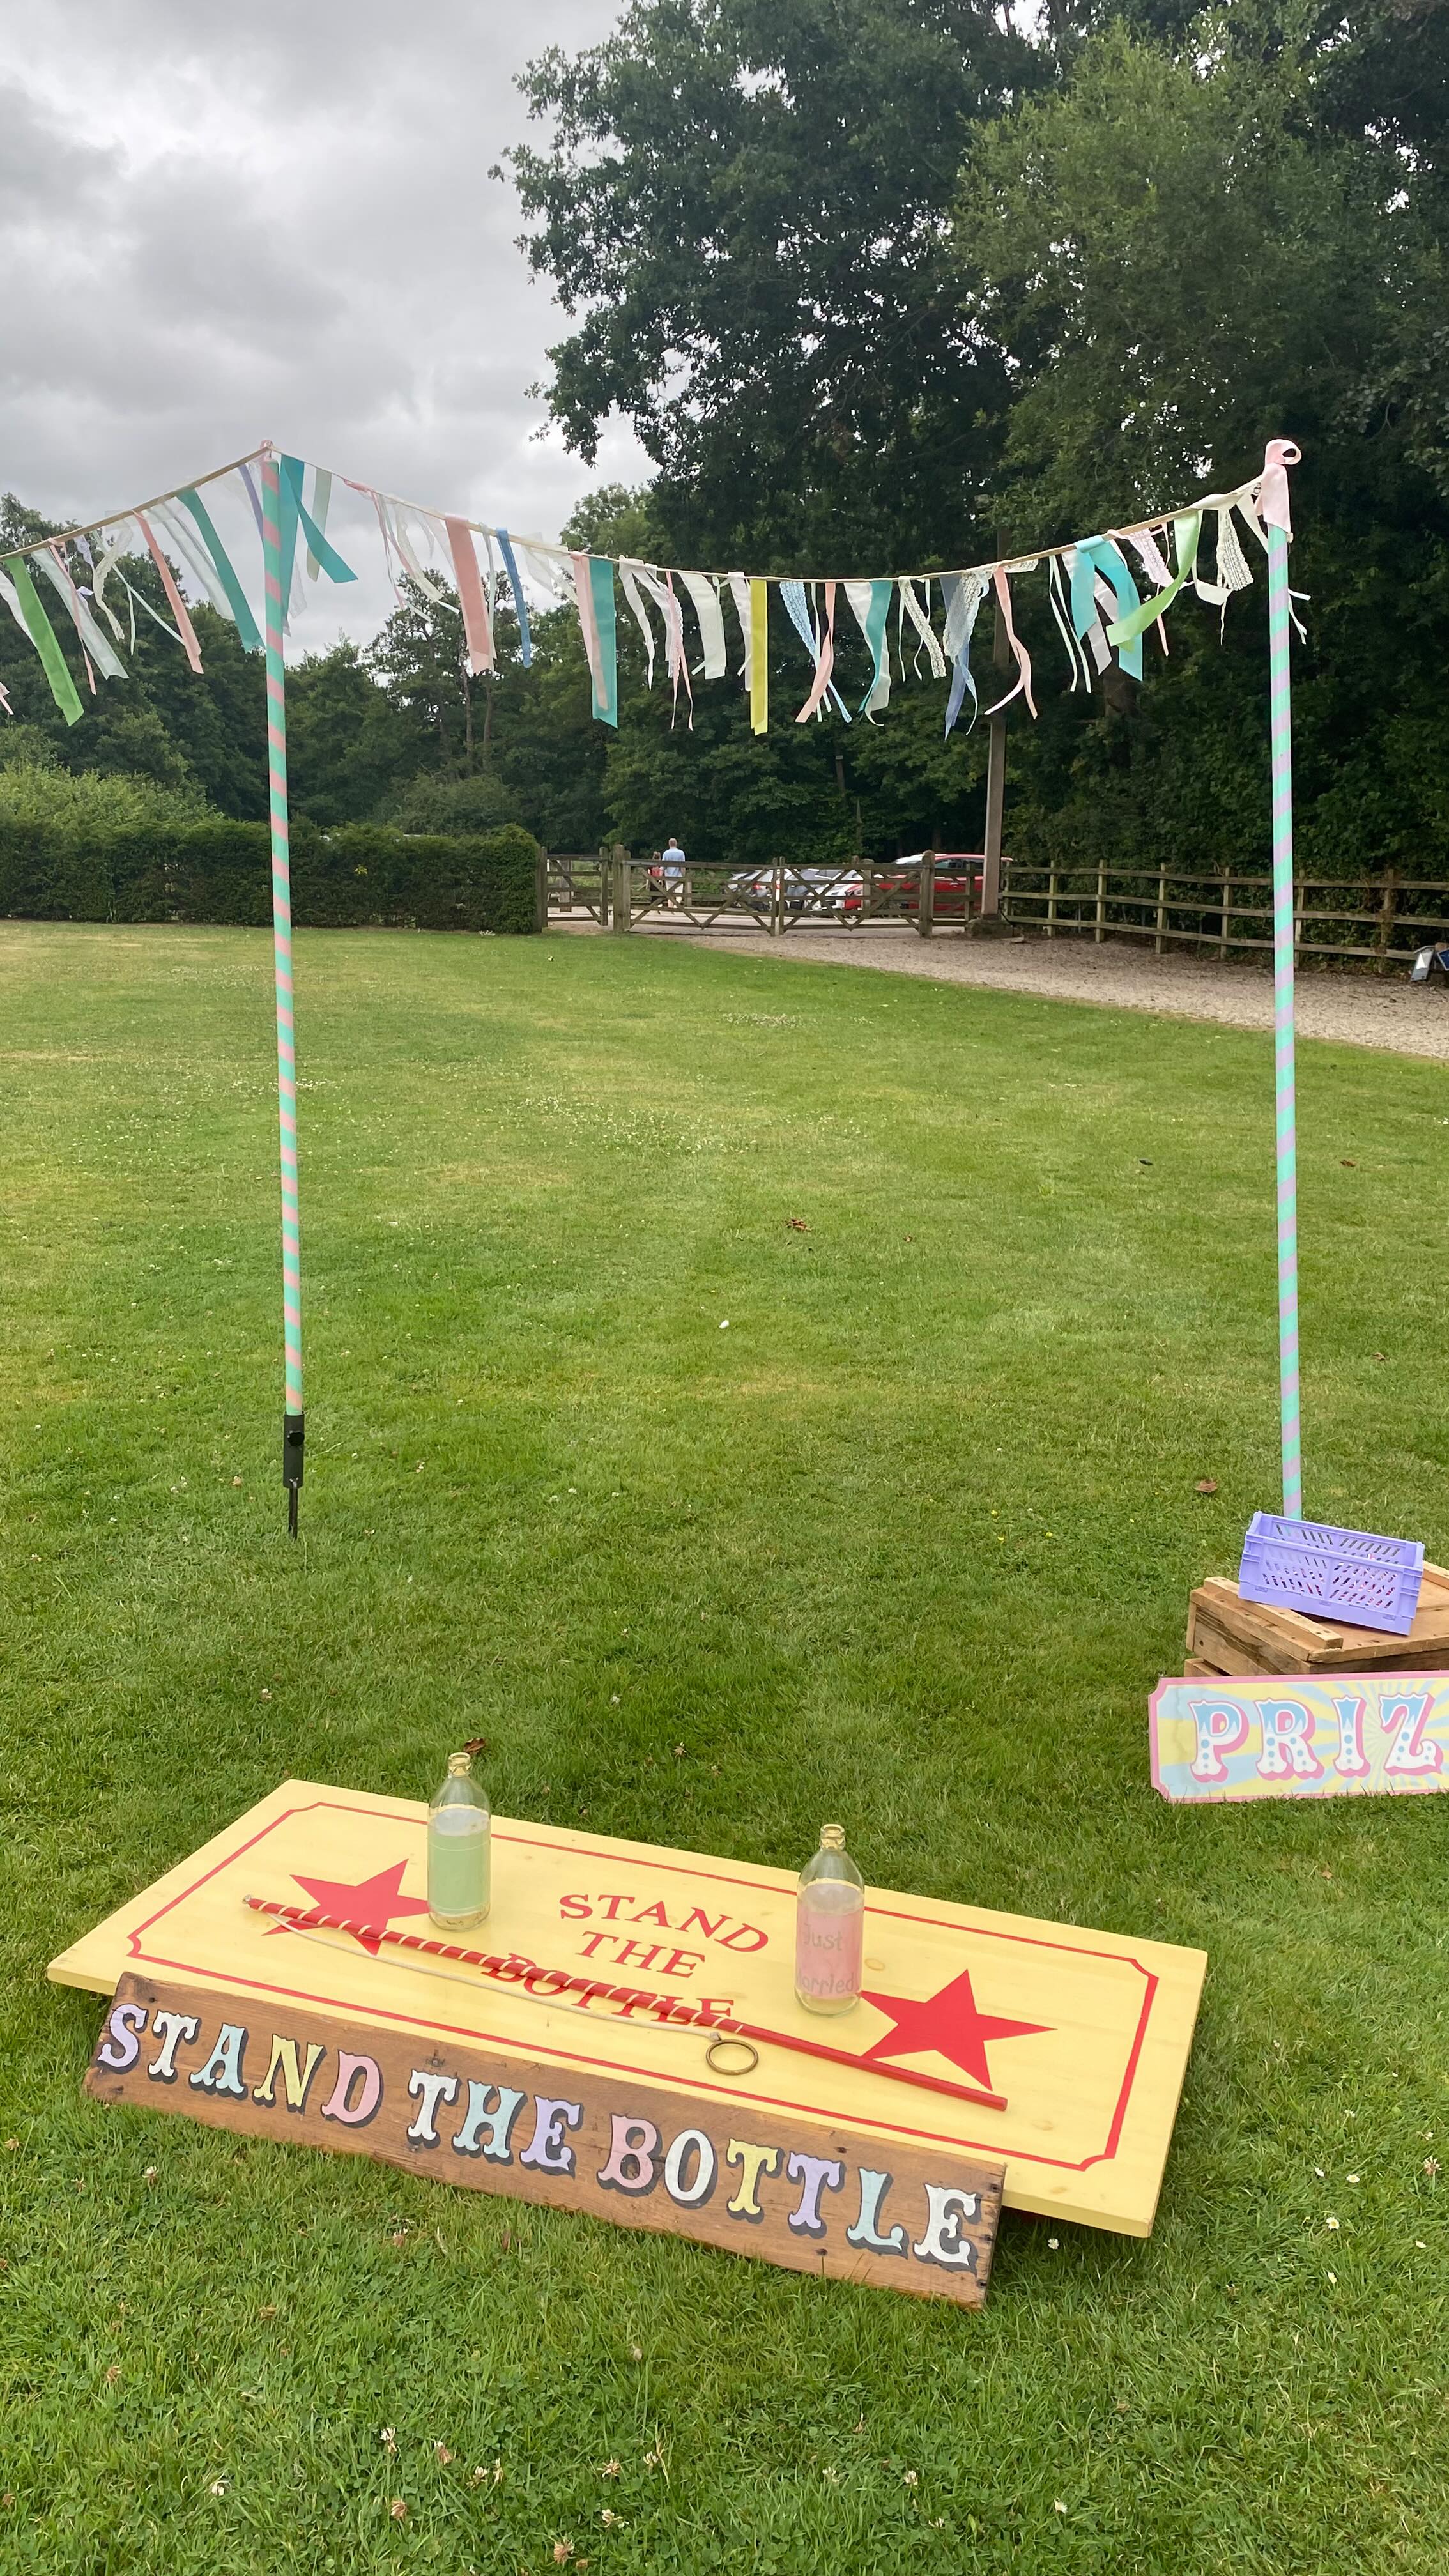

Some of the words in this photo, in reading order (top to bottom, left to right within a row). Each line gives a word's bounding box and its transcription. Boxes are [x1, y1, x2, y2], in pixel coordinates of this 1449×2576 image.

[1187, 1692, 1443, 1783] PRIZ
[559, 1894, 769, 1952] STAND
[802, 1922, 843, 1951] Just
[575, 1931, 705, 1979] THE
[97, 2003, 385, 2129] STAND
[406, 2068, 583, 2175] THE
[596, 2112, 983, 2275] BOTTLE
